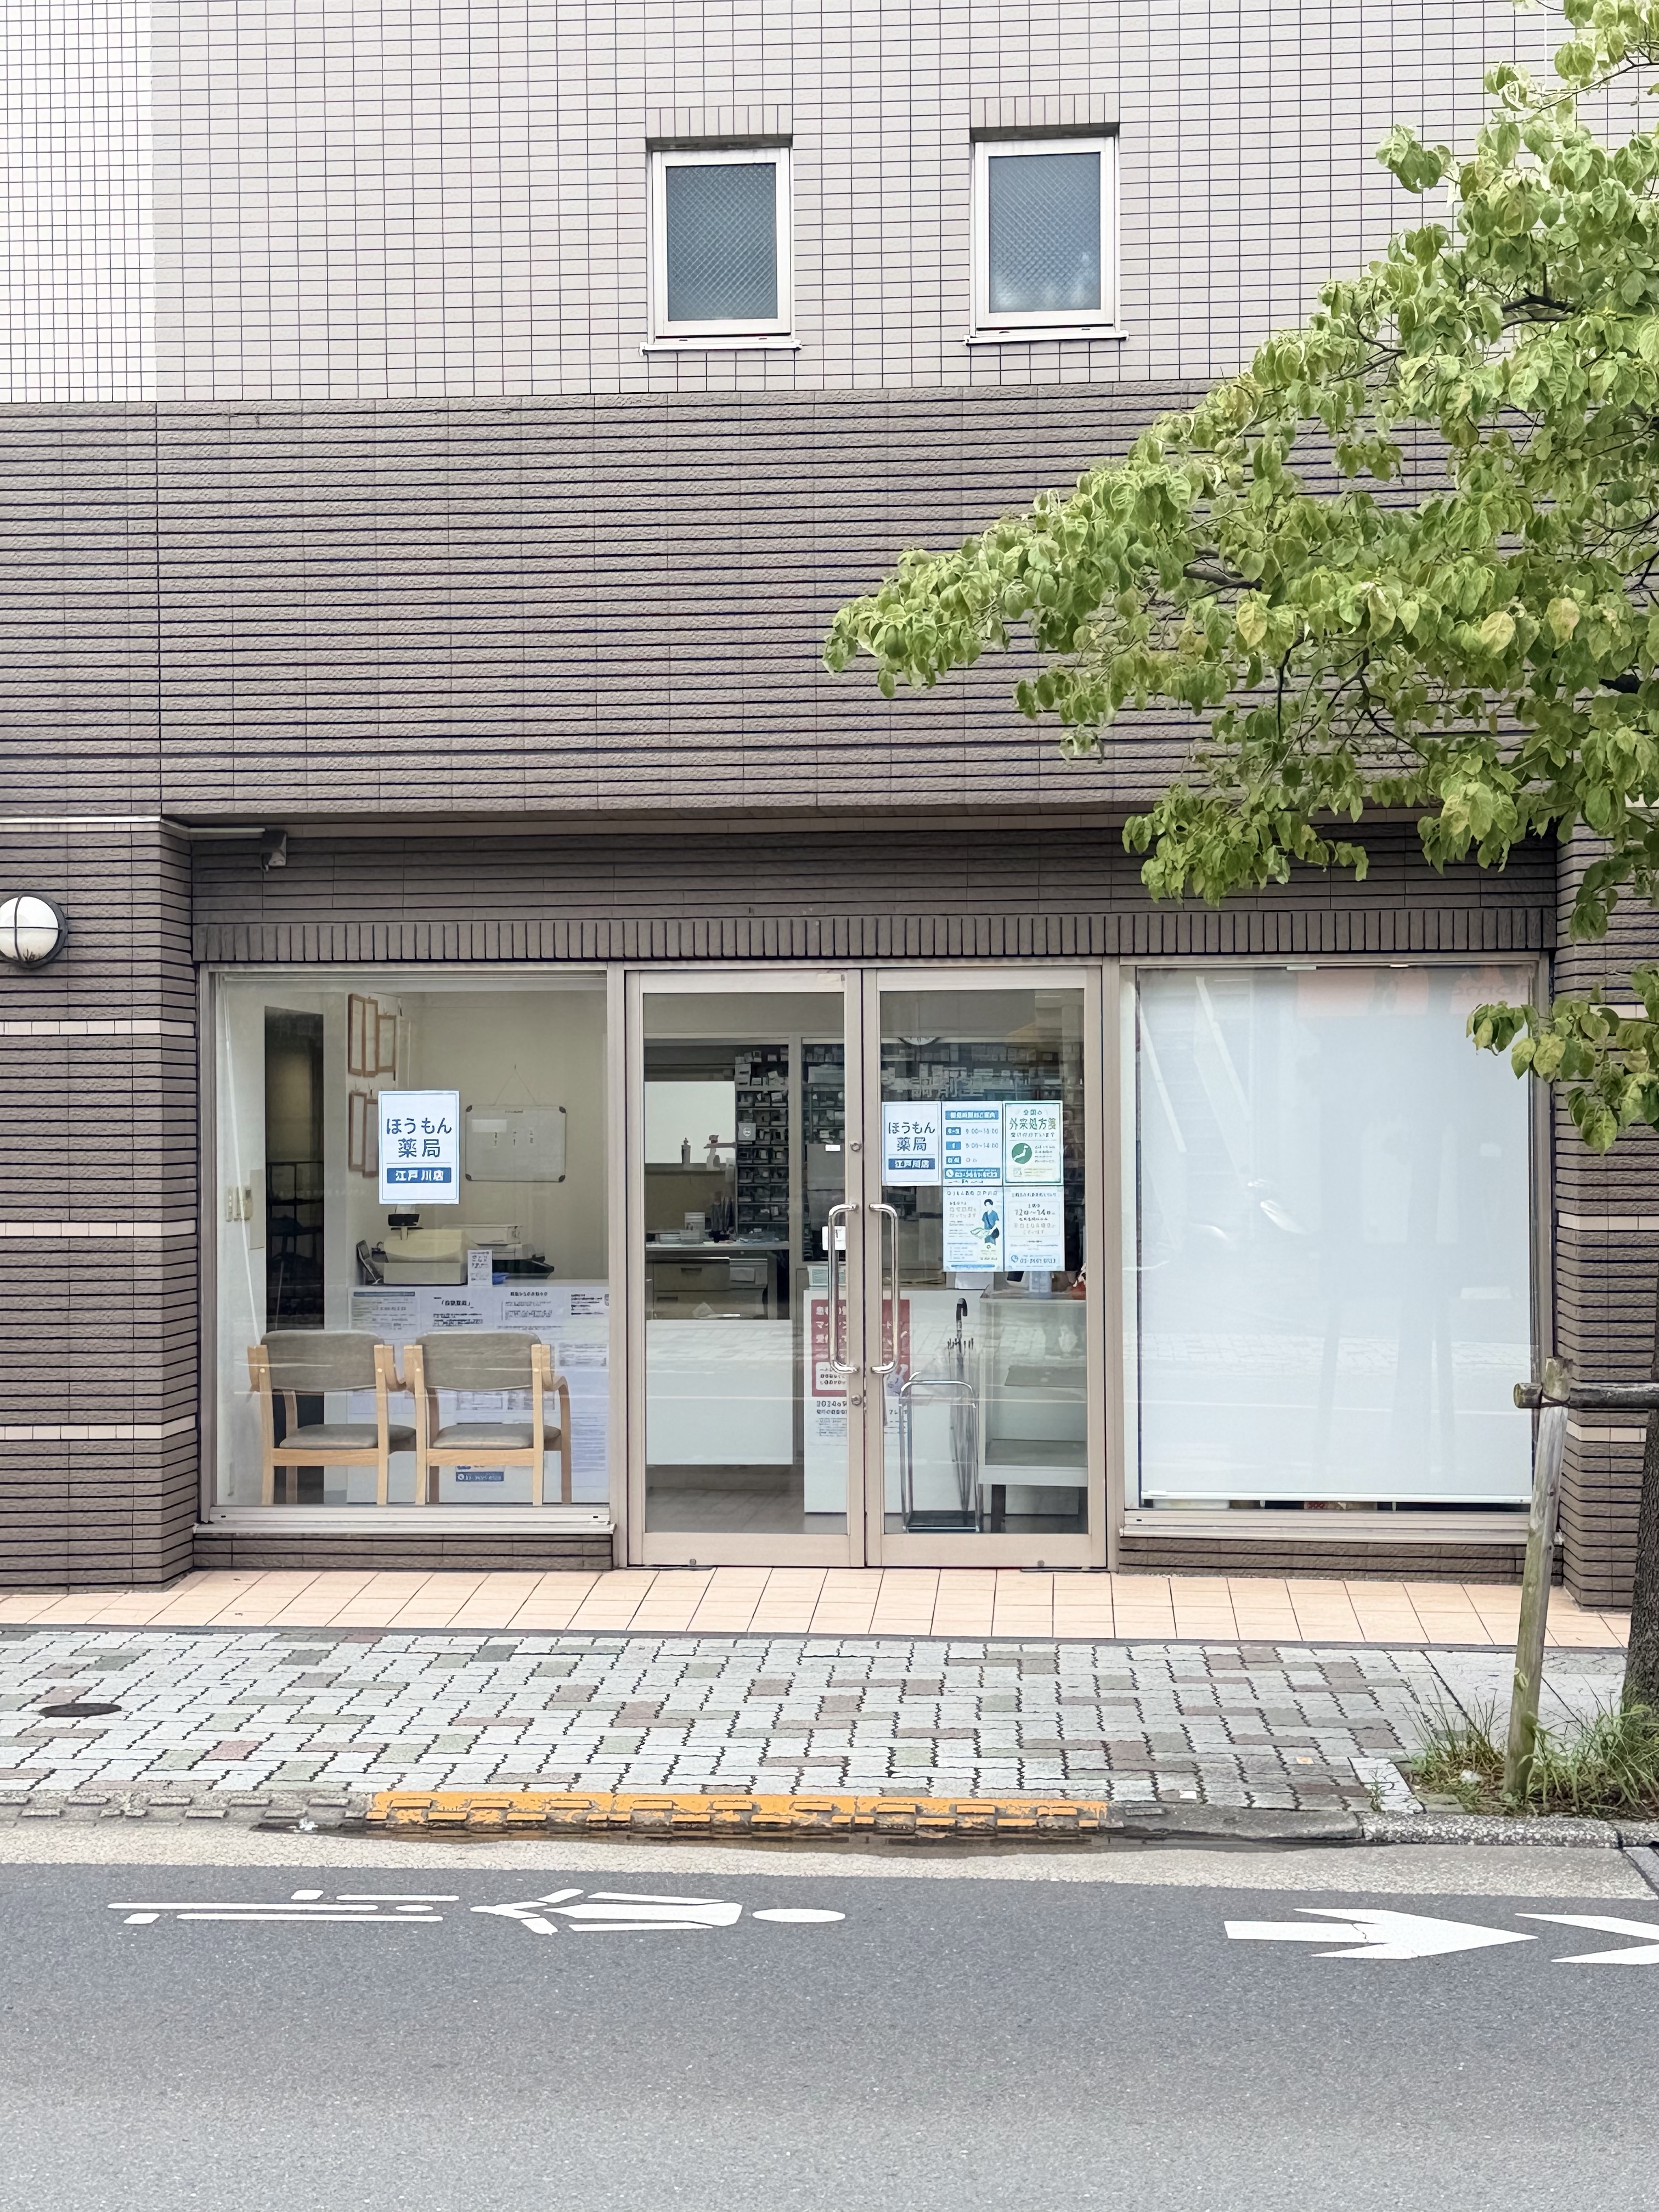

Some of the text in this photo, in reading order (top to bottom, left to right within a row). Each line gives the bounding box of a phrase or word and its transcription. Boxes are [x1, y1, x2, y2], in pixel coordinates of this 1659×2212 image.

[386, 1117, 452, 1135] ほうもん
[888, 1121, 935, 1135] ほうもん
[398, 1138, 441, 1158] 薬局
[896, 1137, 927, 1152] 薬局
[395, 1170, 444, 1181] 江戸川店
